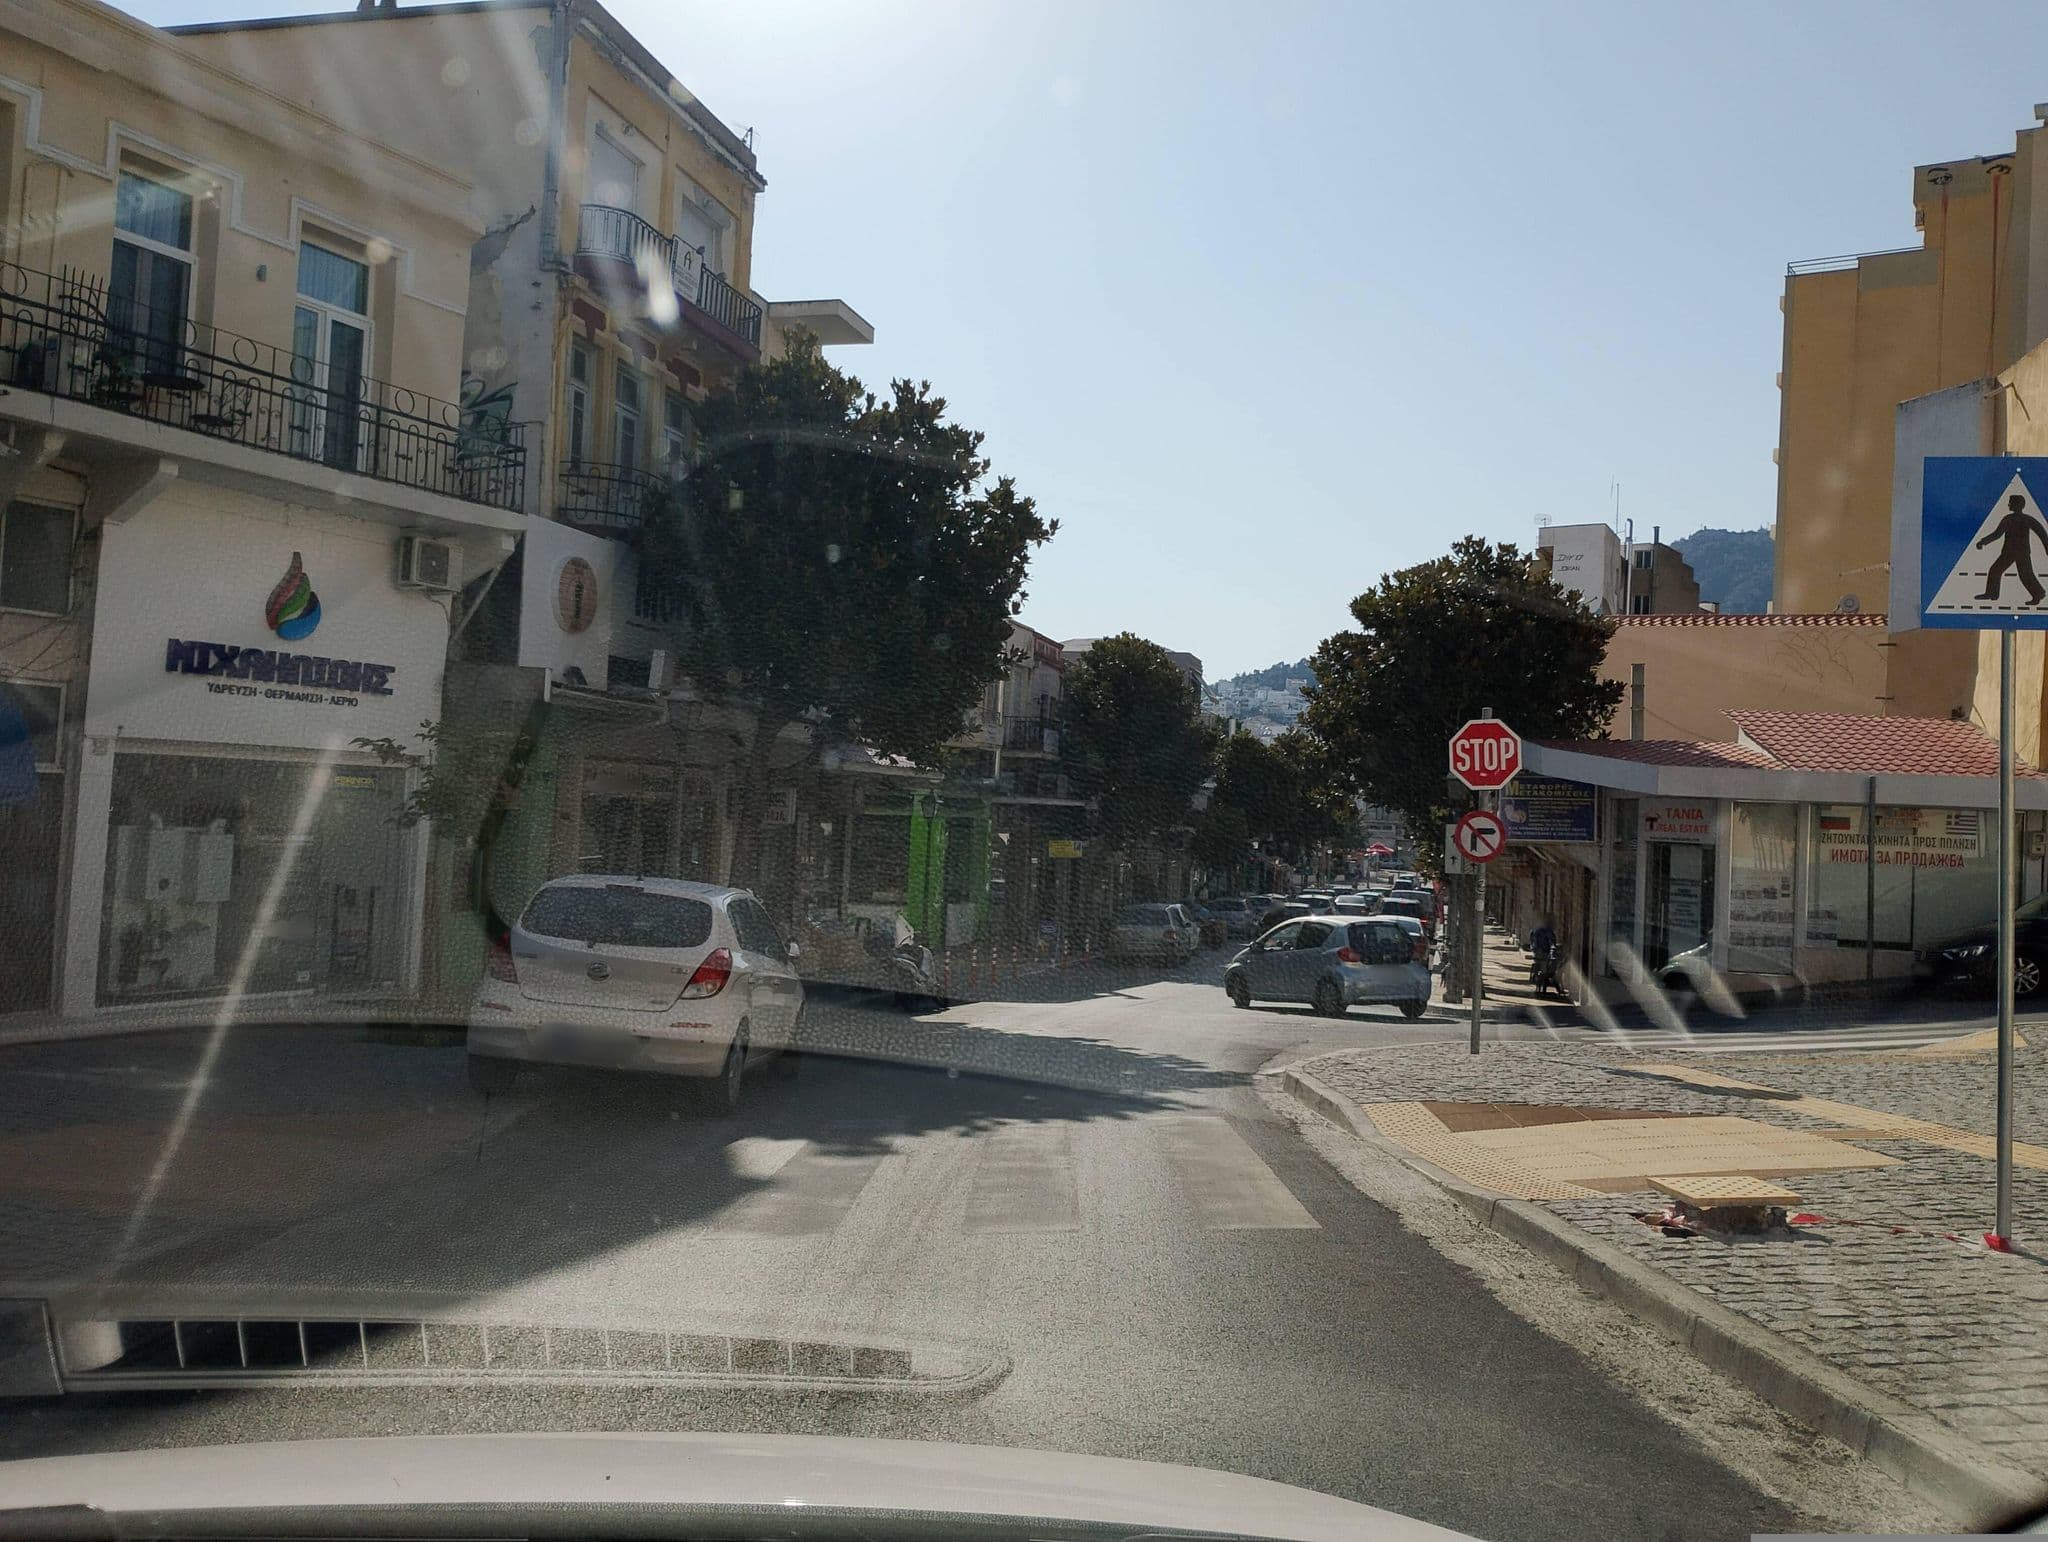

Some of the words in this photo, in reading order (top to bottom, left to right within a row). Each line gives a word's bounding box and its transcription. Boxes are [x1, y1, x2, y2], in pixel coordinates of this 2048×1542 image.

[207, 682, 257, 697] ΥΔΡΕΥΣΗ
[264, 688, 323, 703] ΘΕΡΜΑΝΣΗ
[329, 695, 359, 707] ΑΕΡΙΟ
[1456, 737, 1515, 772] STOP
[1665, 807, 1704, 819] TANIA
[1912, 836, 1937, 848] ΠΡΟΣ
[1940, 838, 1976, 850] ΠΩΛΗΣΗ
[1876, 850, 1891, 865] ЗА
[1895, 850, 1965, 868] ПРОДАЖБА
